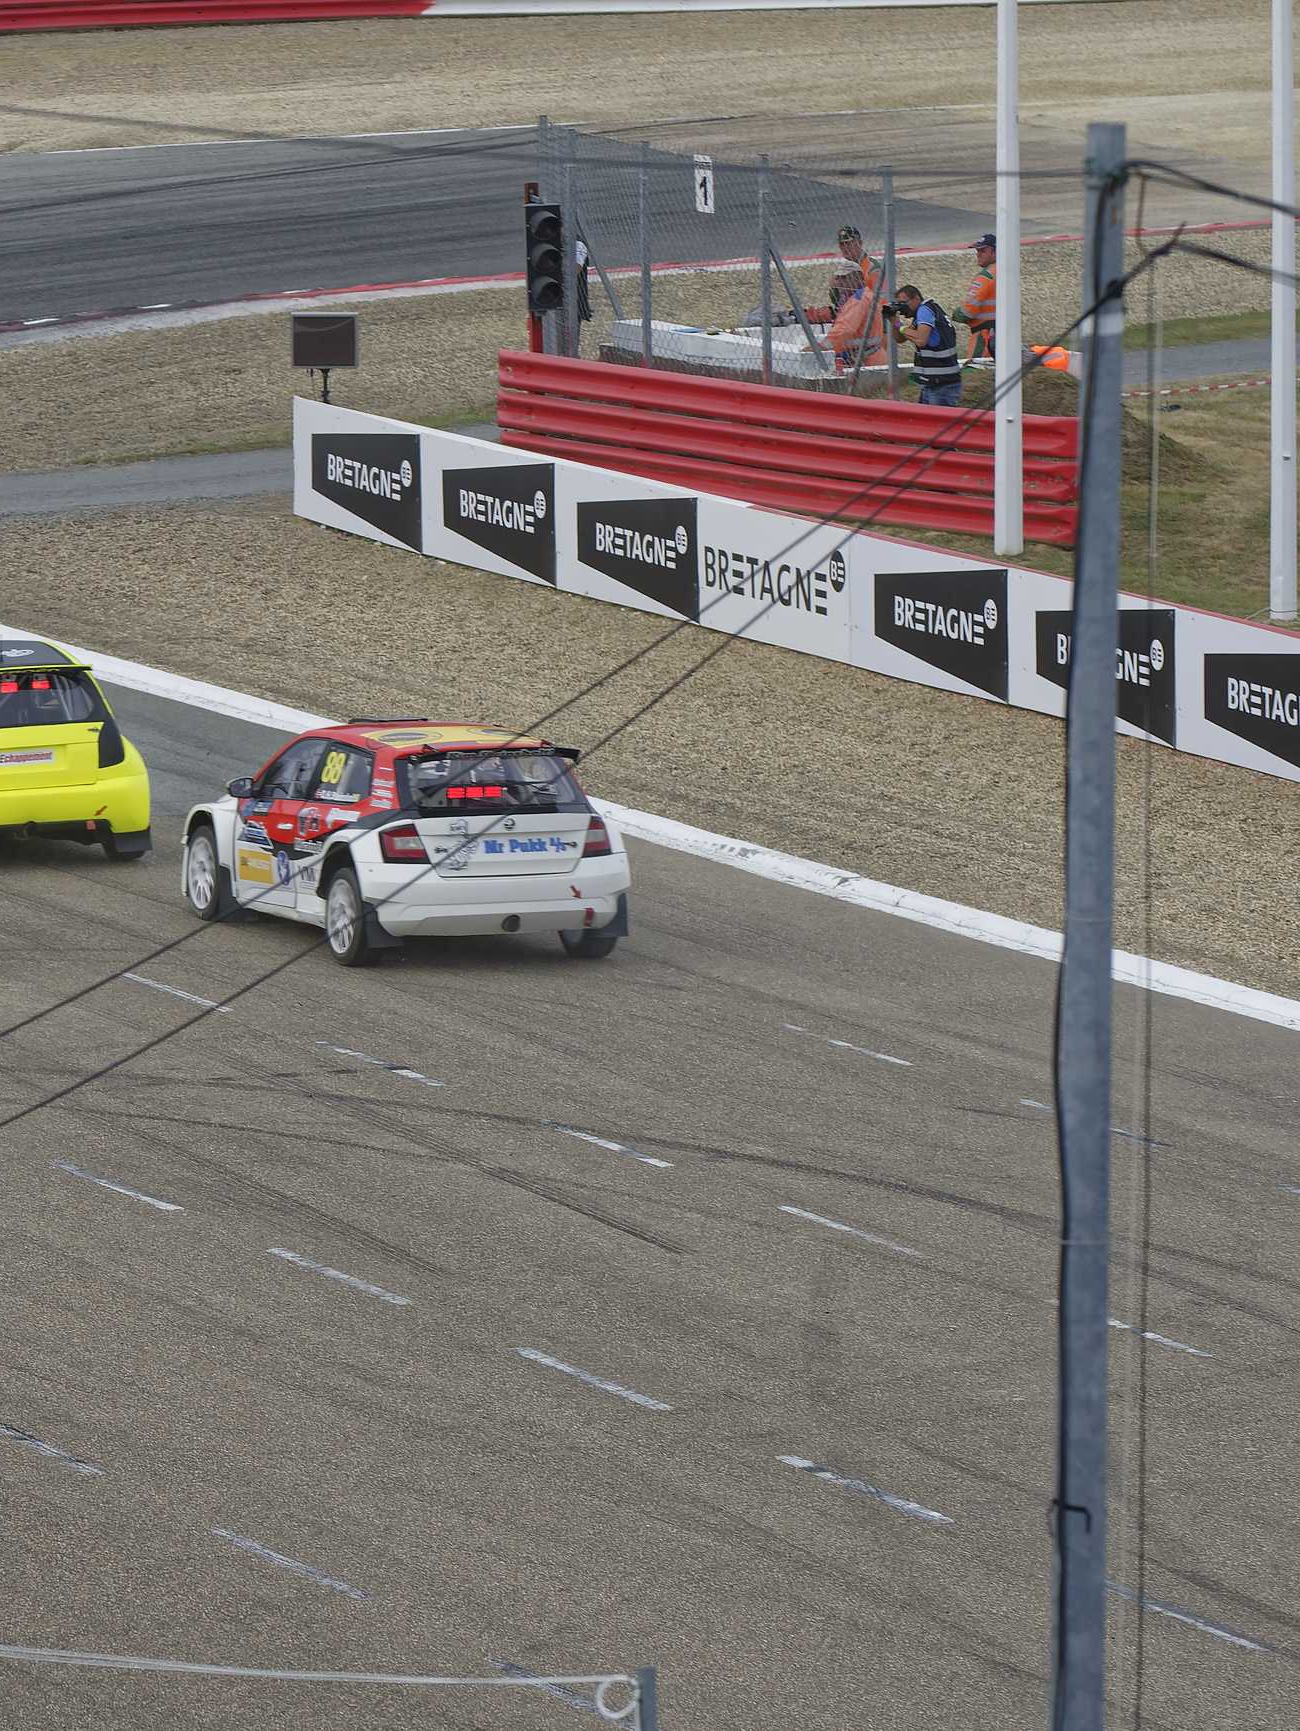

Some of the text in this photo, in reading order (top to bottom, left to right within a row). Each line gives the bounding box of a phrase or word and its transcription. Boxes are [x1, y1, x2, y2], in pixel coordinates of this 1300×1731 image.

[699, 175, 708, 206] 1
[326, 453, 402, 502] BRETAGNE
[460, 489, 535, 534] BRETAGNE
[595, 521, 677, 570] BRETAGNE
[703, 545, 828, 616] BRETAGNE
[894, 595, 985, 646] BRETAGNE
[1227, 676, 1300, 727] BRETAG
[320, 751, 347, 784] 88
